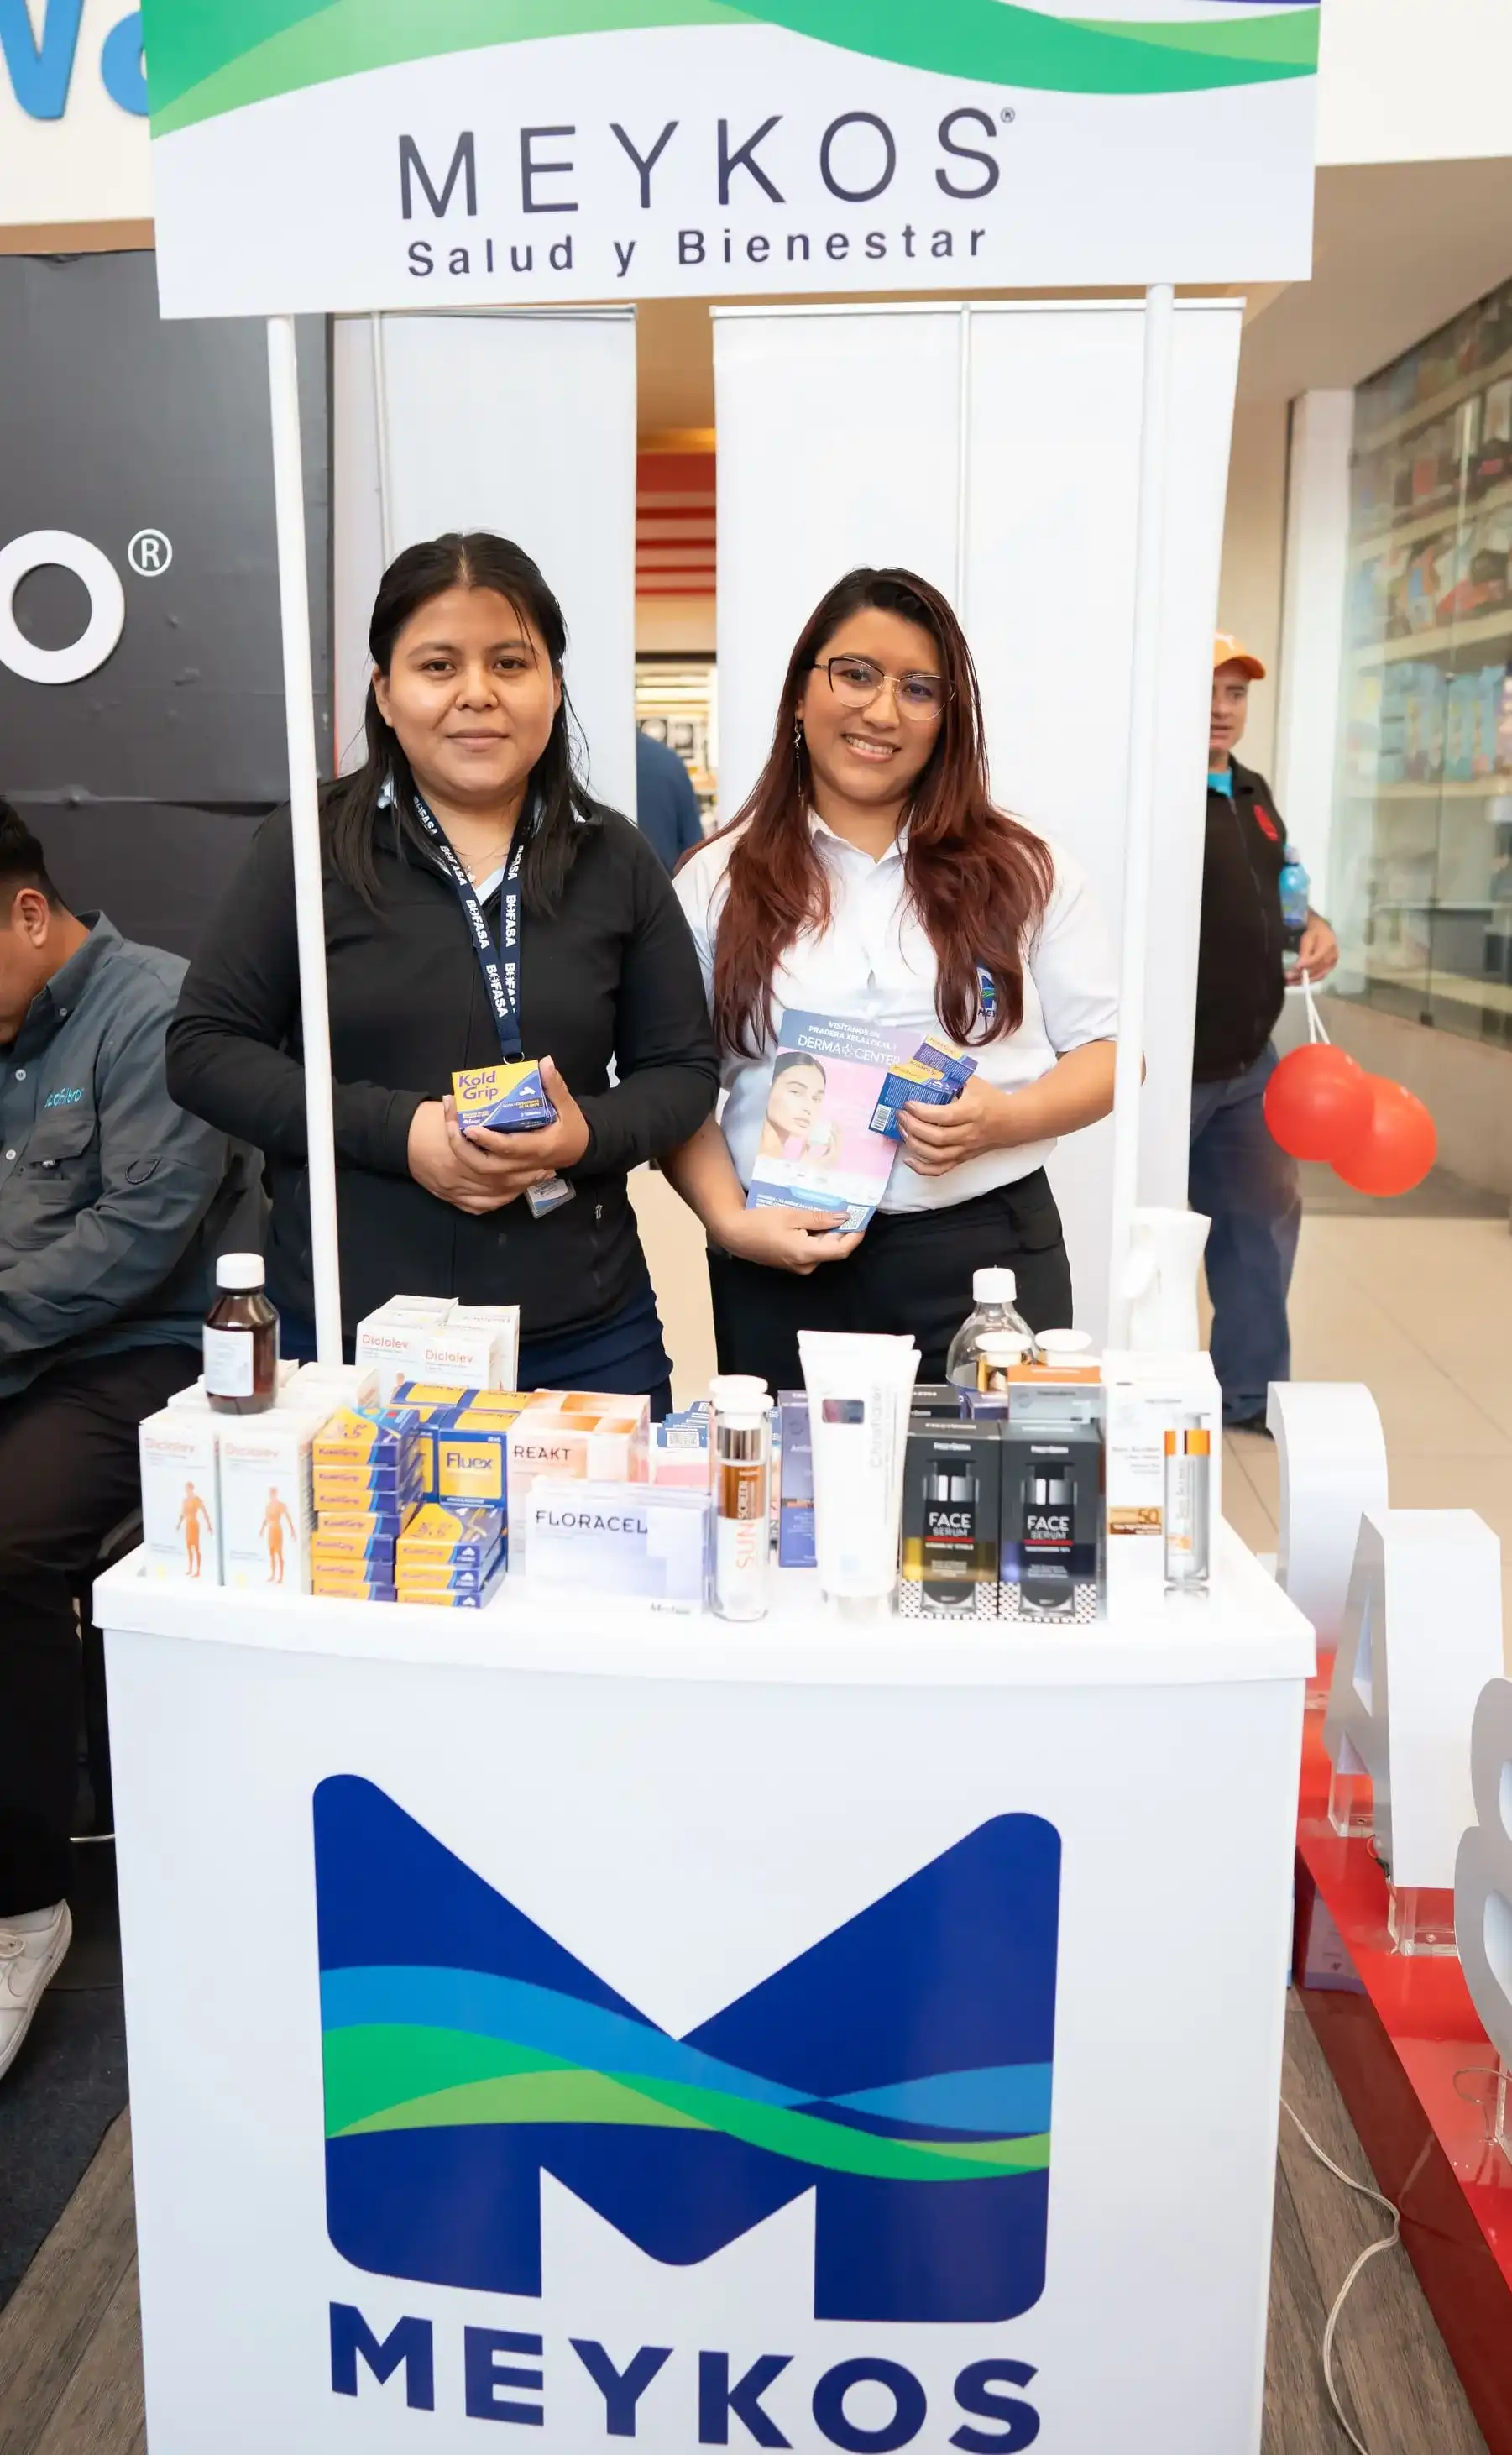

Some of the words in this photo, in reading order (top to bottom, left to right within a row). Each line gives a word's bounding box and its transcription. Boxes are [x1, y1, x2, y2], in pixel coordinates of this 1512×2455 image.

[408, 235, 573, 276] Salud
[614, 241, 636, 277] y
[678, 225, 985, 264] Bienestar
[808, 1025, 845, 1039] PRADERA
[798, 1034, 840, 1055] DERMA
[458, 1071, 496, 1087] Kold
[463, 1086, 499, 1101] Grip
[447, 1452, 494, 1469] Fluex
[514, 1445, 572, 1461] REAKT
[536, 1510, 648, 1535] FLORACEL
[929, 1512, 971, 1528] FACE
[1027, 1515, 1070, 1531] FACE
[932, 1526, 967, 1537] SERUM
[1030, 1531, 1067, 1540] SERUM
[329, 2301, 1040, 2455] MEYKOS
